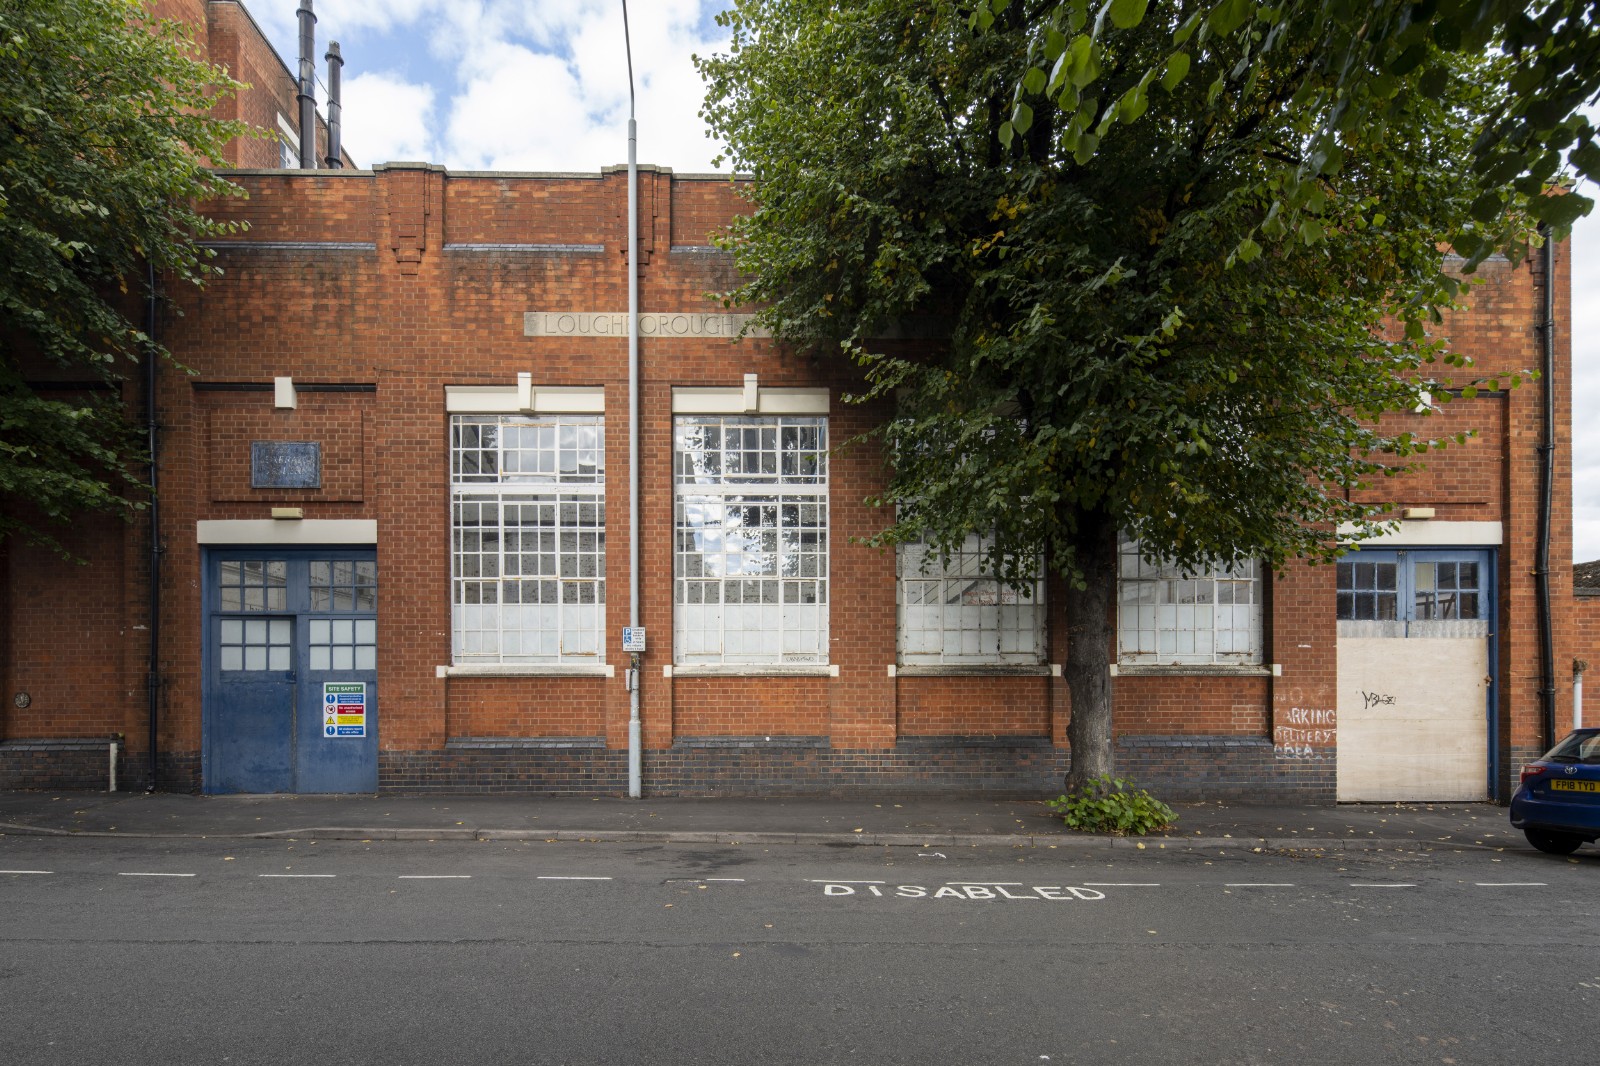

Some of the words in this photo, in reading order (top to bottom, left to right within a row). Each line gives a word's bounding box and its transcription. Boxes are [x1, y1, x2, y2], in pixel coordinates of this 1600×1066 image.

[1275, 707, 1336, 726] ARKING
[1556, 780, 1575, 790] FP18
[823, 884, 1106, 900] DISABLED
